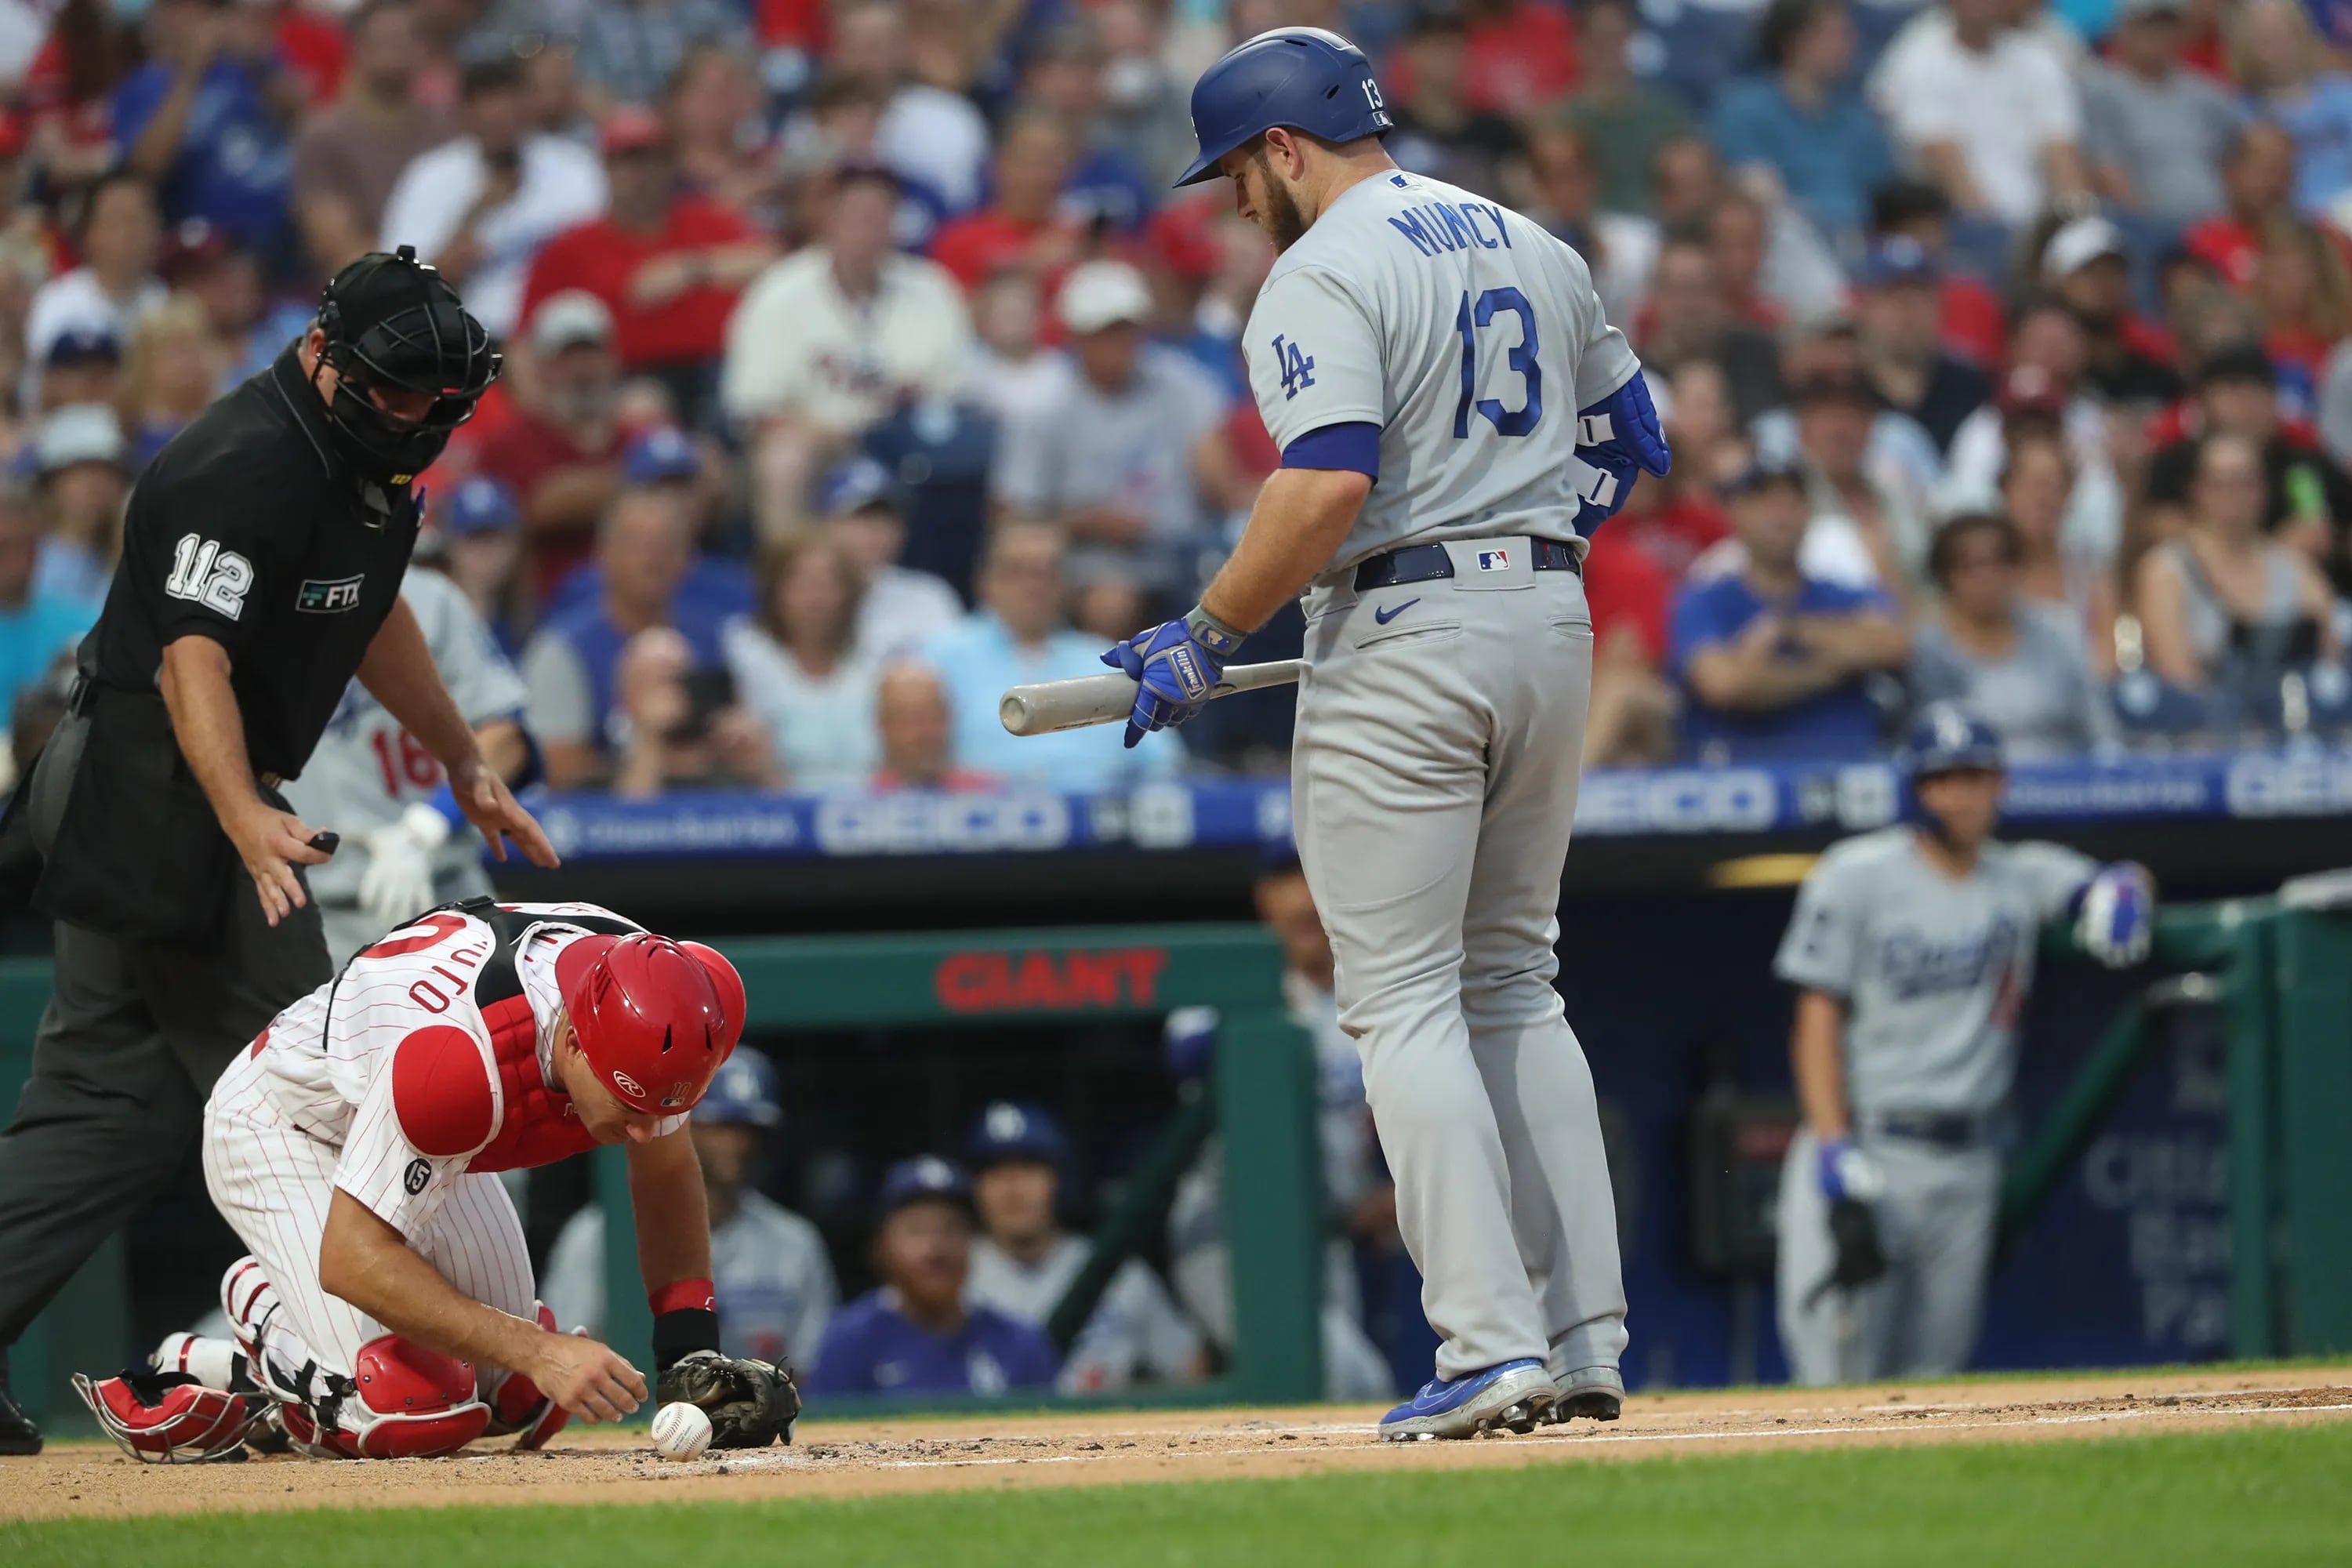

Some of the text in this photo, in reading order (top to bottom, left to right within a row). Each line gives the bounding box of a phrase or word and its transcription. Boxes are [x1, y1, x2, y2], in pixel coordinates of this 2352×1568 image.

[1362, 78, 1383, 109] 13
[1387, 201, 1512, 257] MUNCY
[1272, 333, 1316, 401] LA
[1454, 287, 1542, 438] 13
[165, 532, 255, 621] 112
[815, 792, 1069, 855] GEICO
[934, 946, 1169, 1013] GIANT
[406, 1161, 430, 1191] 15
